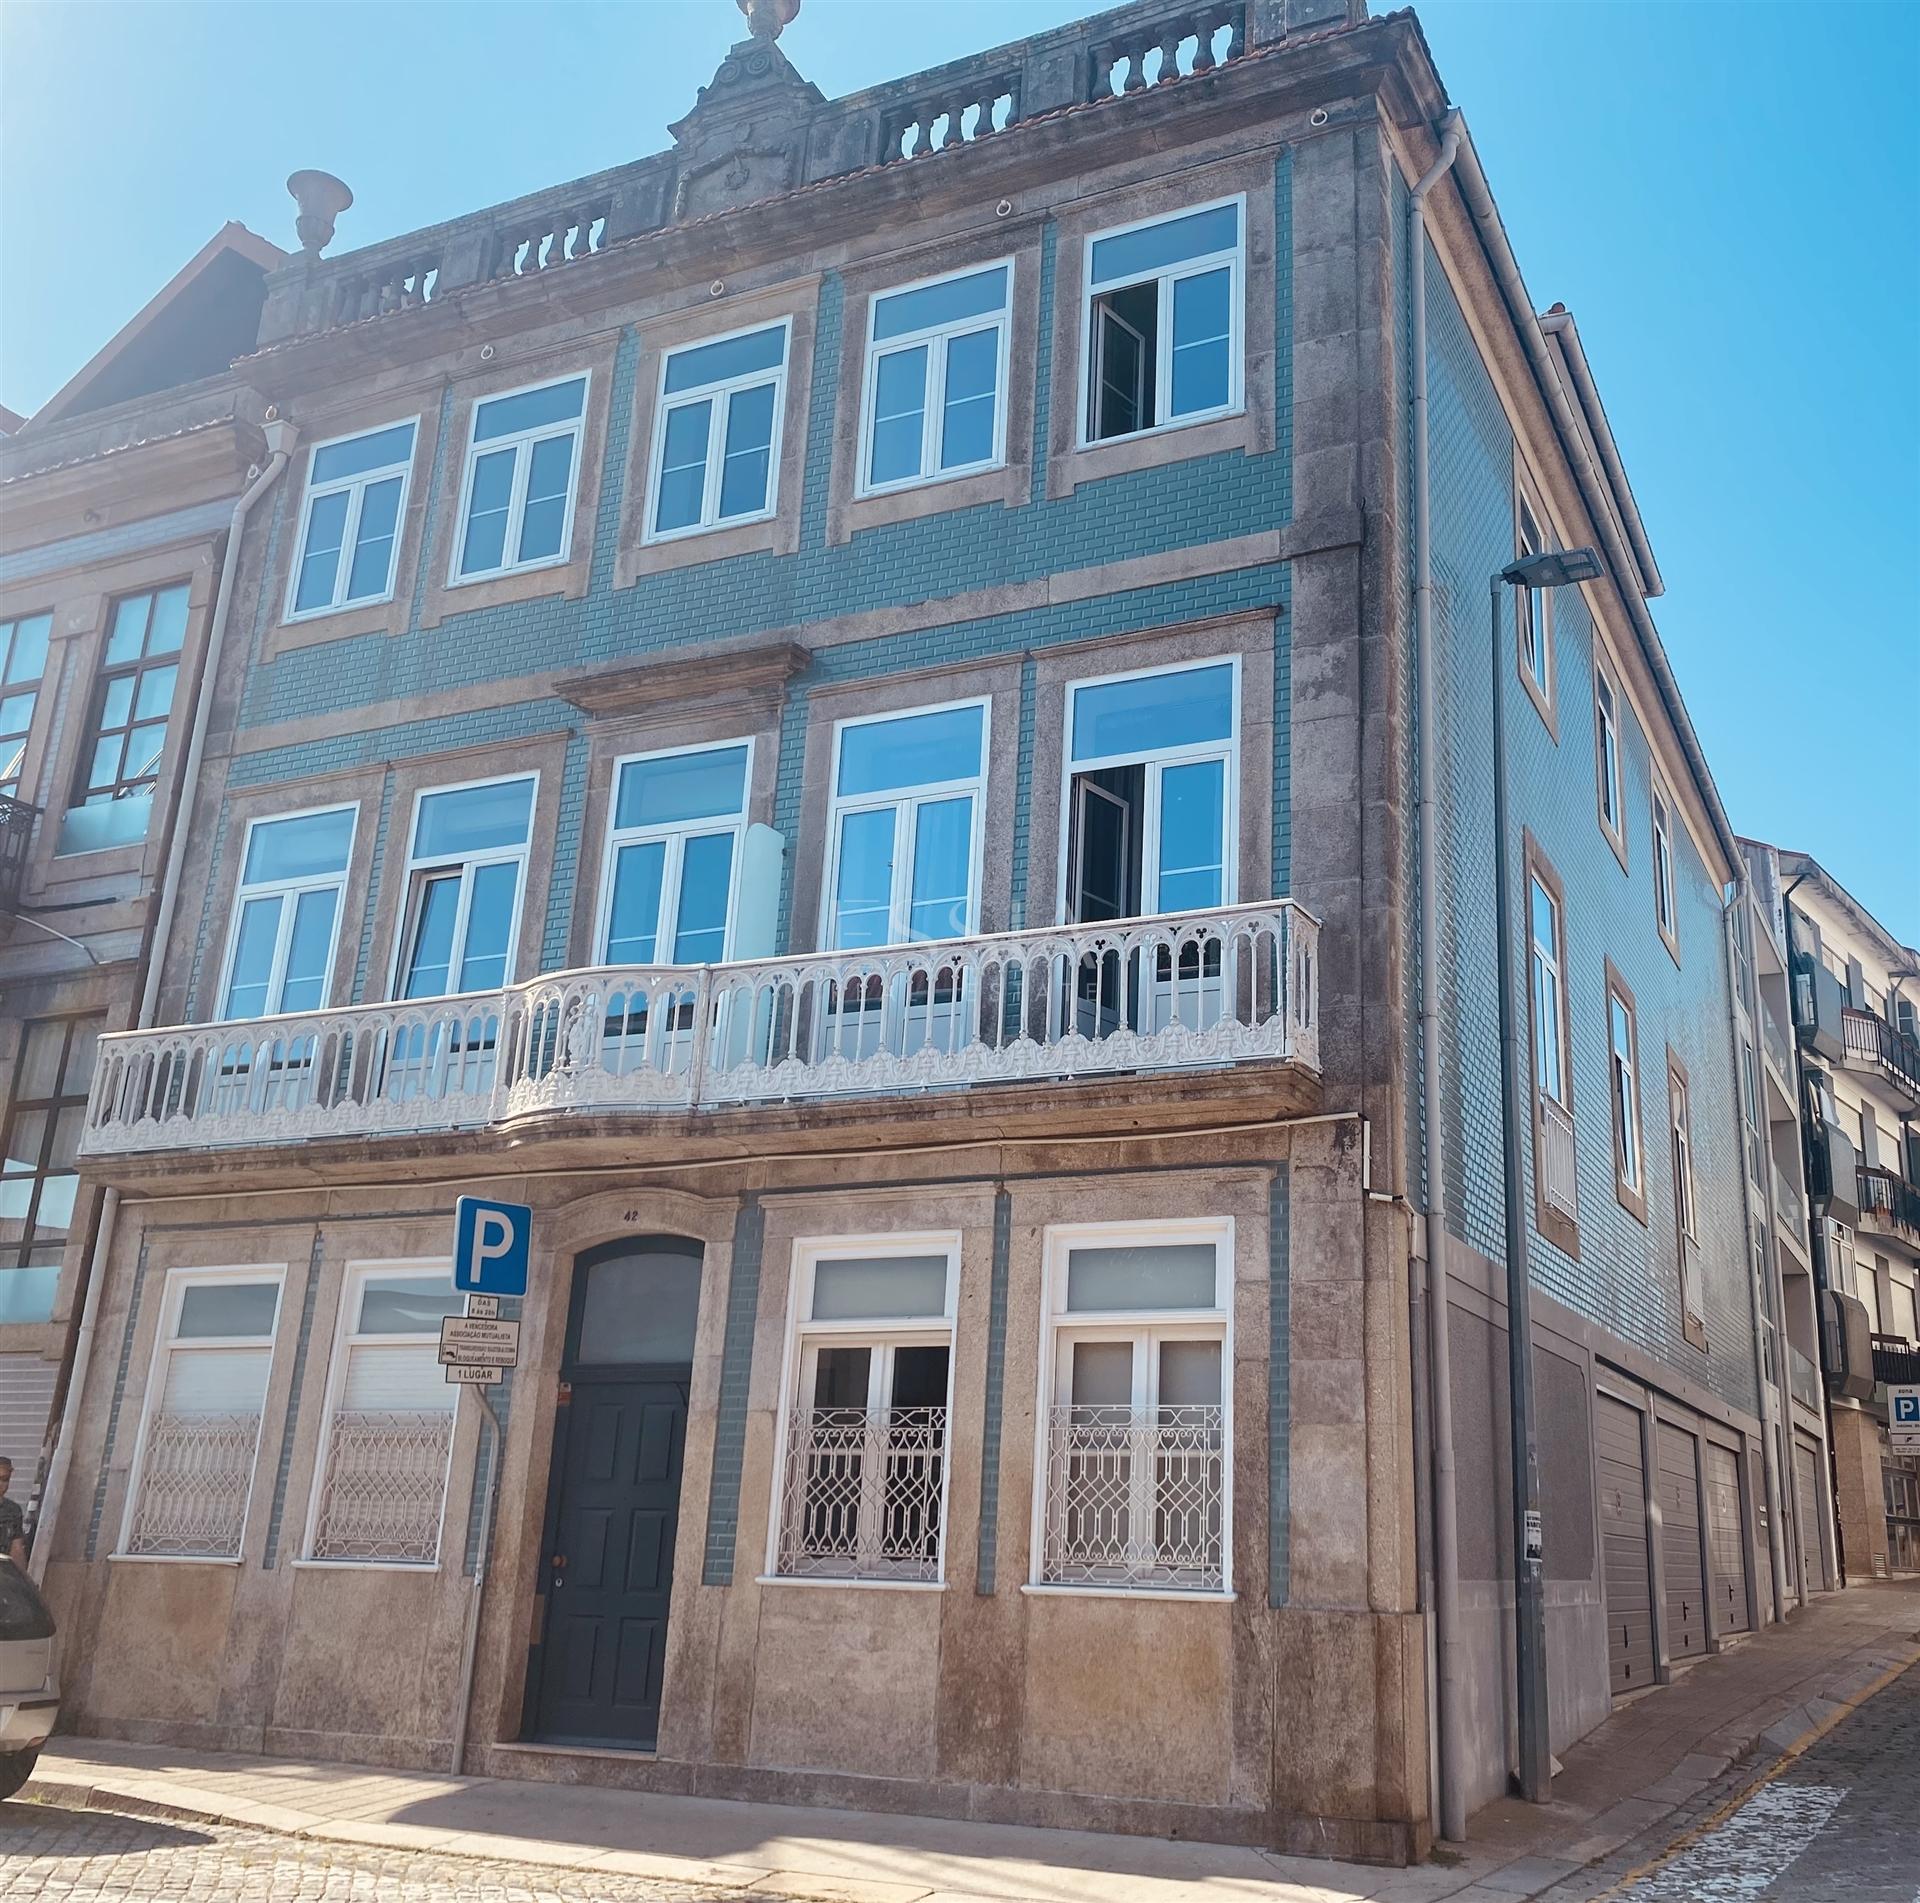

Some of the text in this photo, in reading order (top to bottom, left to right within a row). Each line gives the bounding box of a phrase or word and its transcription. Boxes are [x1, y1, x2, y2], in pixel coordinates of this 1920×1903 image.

[470, 1208, 514, 1283] P
[458, 1369, 493, 1379] 1 LUGAR
[1900, 1399, 1914, 1419] P
